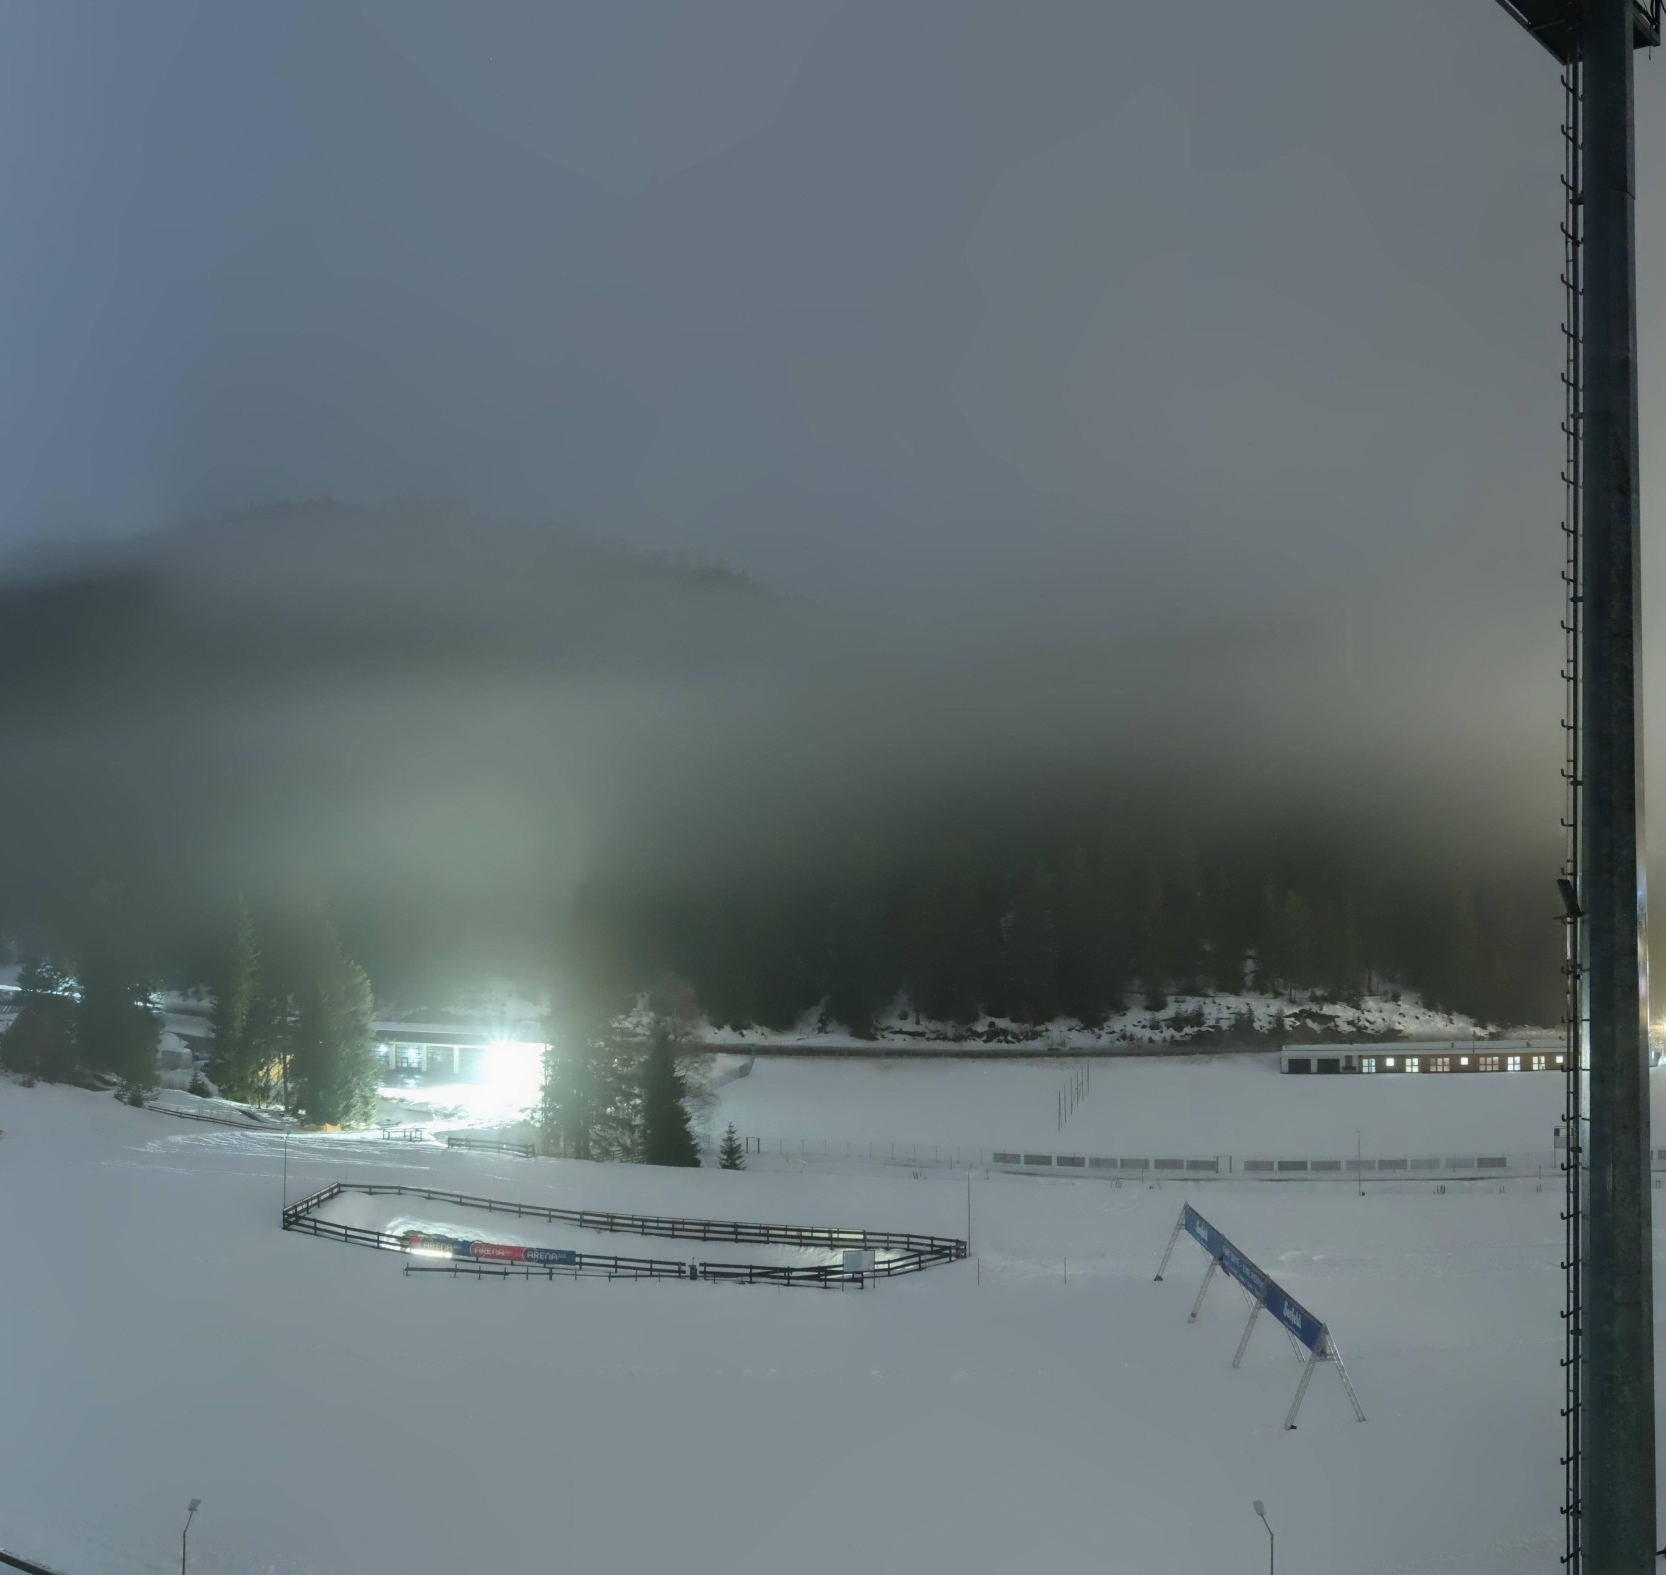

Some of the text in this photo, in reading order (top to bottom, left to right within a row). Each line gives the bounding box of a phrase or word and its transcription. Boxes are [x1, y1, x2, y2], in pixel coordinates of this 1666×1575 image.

[423, 1241, 453, 1251] ARENA
[474, 1247, 505, 1256] ARENA
[526, 1250, 558, 1260] ARENA
[1283, 1300, 1302, 1329] Seefeld
